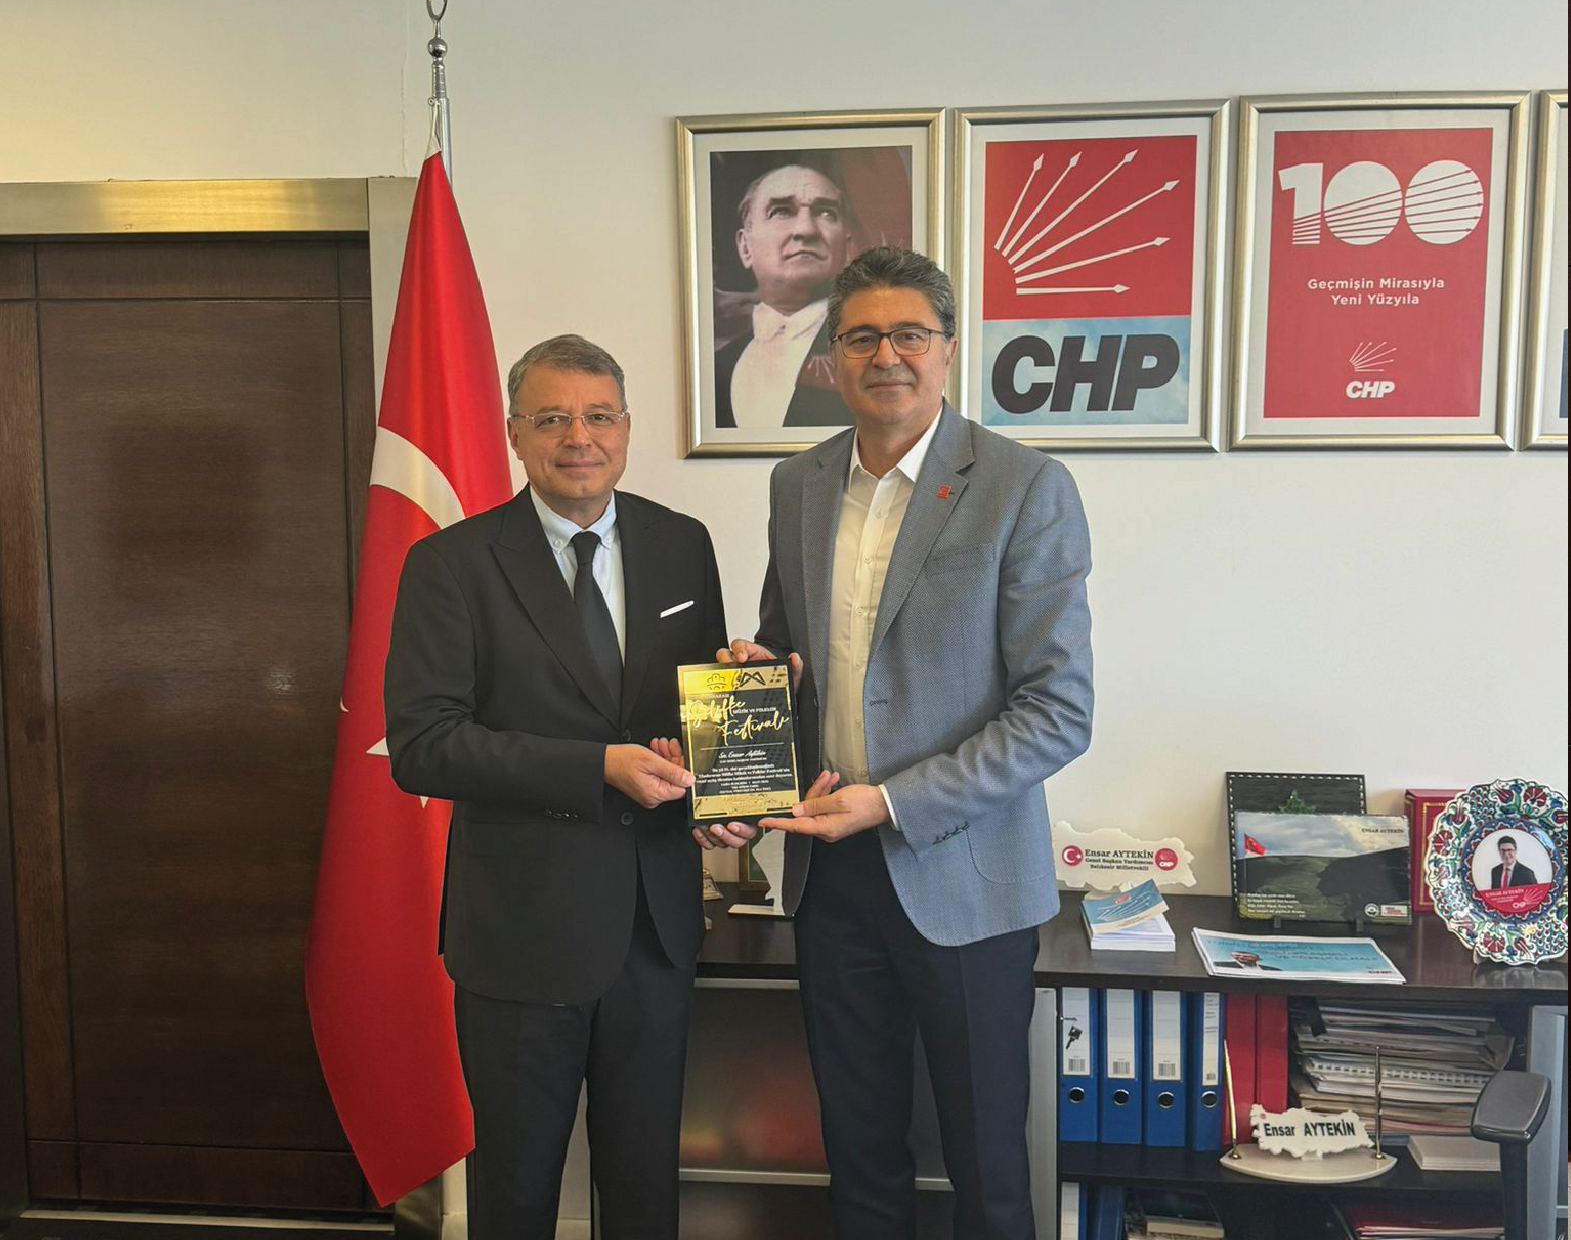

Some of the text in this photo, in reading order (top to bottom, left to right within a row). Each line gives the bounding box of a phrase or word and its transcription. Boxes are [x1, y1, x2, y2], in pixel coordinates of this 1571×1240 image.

[1278, 160, 1484, 246] 100
[1308, 276, 1445, 292] Geçmişin Mirasıyla
[1331, 292, 1420, 307] Yeni Yüzyıla
[991, 334, 1180, 415] CHP
[1346, 380, 1396, 399] CHP
[1085, 848, 1154, 859] Ensar AYTEKİN
[1263, 1119, 1356, 1136] Ensar AYTEKİN
